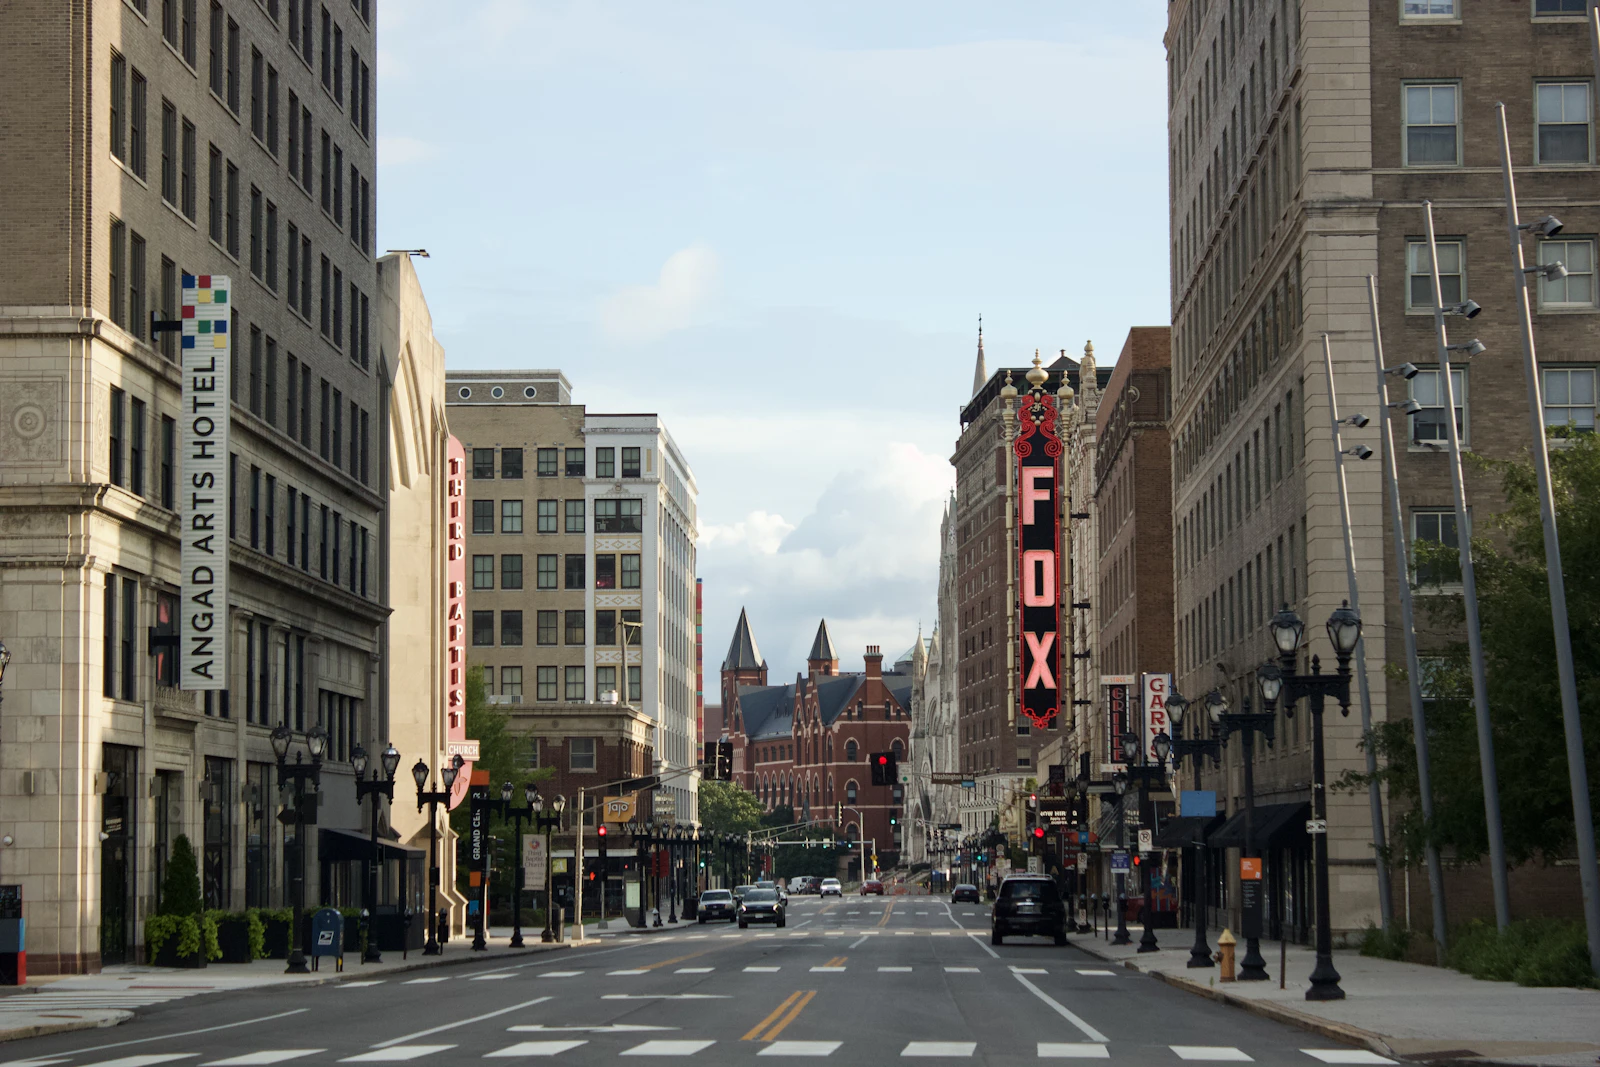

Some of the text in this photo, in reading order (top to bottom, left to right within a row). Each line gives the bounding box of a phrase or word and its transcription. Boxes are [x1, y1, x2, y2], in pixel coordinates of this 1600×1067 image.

[191, 356, 216, 680] ANGAD ARTS HOTEL
[450, 457, 464, 729] THIRD BAPTIST
[1022, 466, 1057, 690] FOX
[448, 744, 479, 756] CHURCH
[1111, 688, 1124, 761] GRILLE
[933, 774, 963, 782] Washington
[472, 792, 481, 860] GRAND CENR
